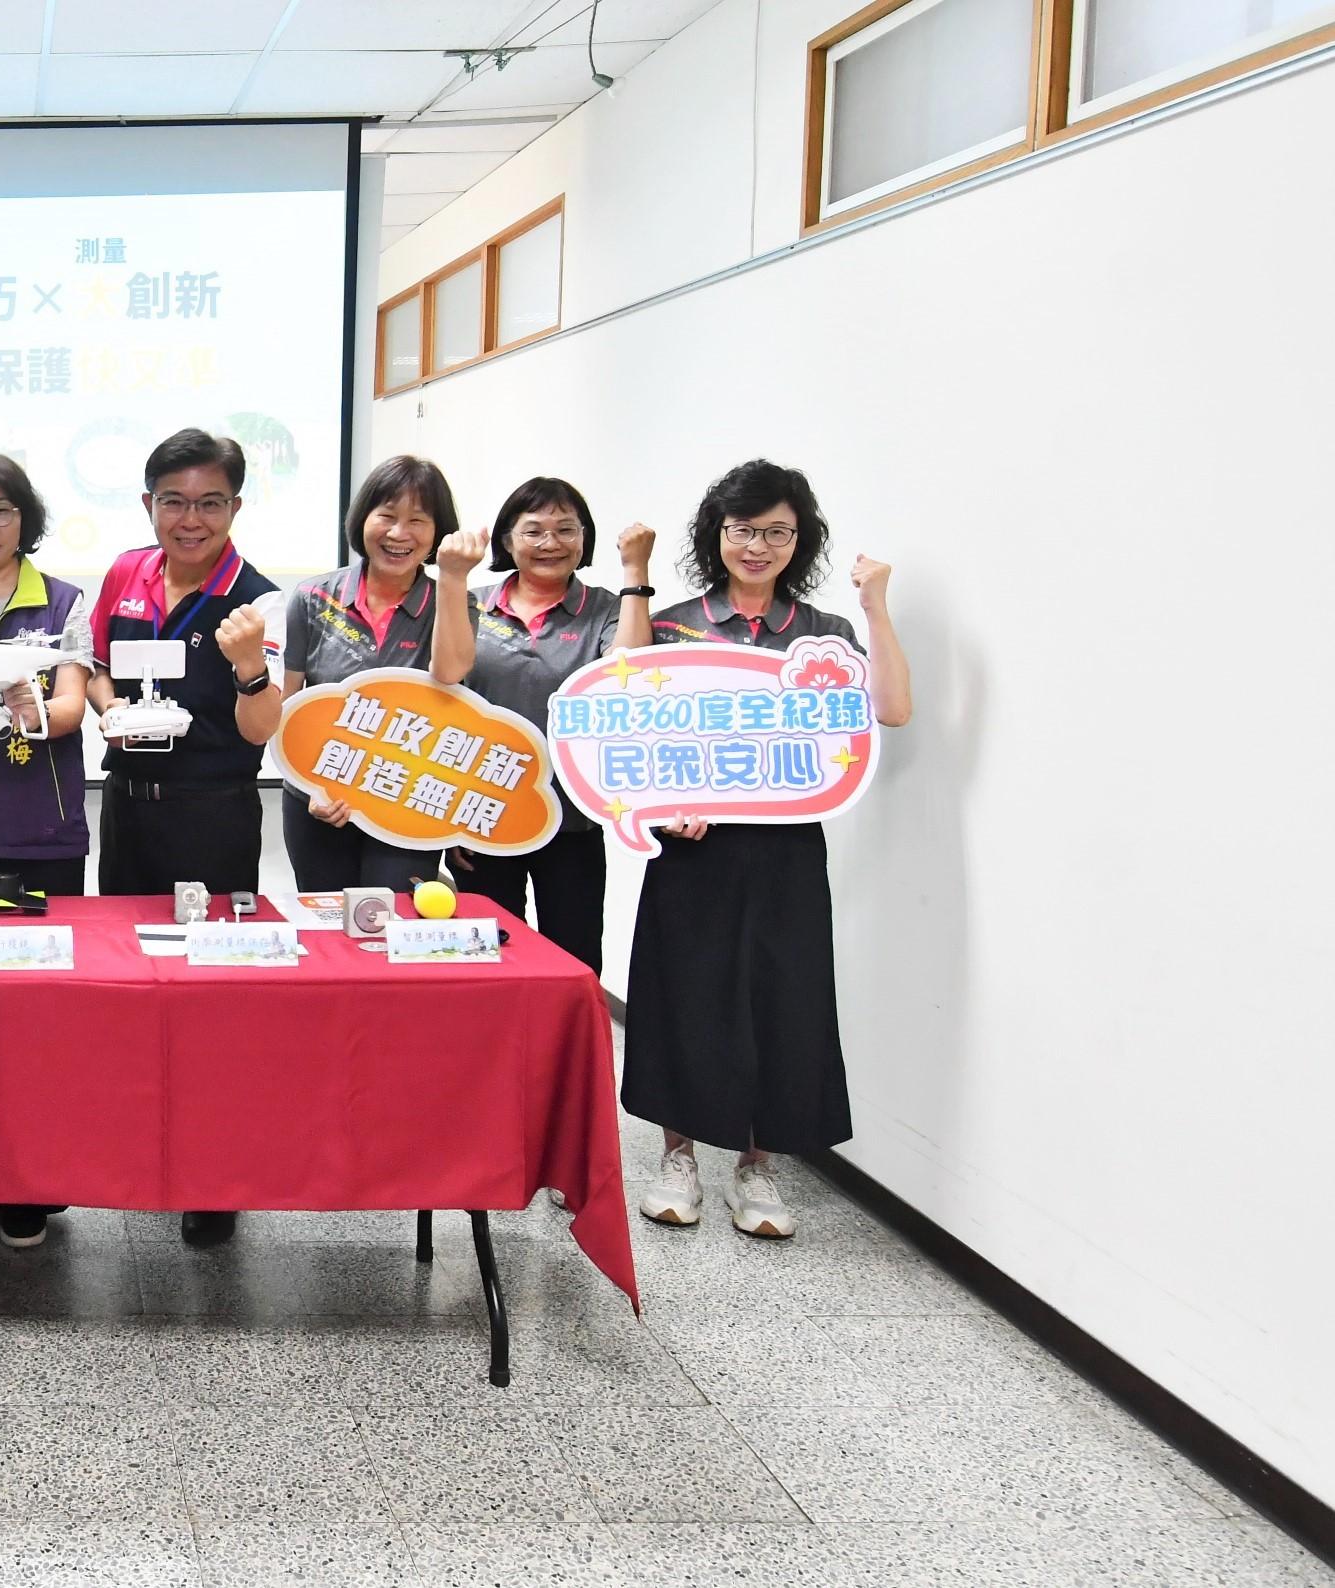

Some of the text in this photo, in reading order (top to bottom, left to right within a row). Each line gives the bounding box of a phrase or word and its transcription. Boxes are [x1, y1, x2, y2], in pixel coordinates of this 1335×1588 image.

[74, 237, 128, 265] 測量
[119, 599, 145, 612] FILA
[399, 641, 418, 649] FILA
[559, 633, 579, 641] FILA
[555, 691, 865, 734] 現況360度全紀錄
[7, 725, 33, 766] 梅
[333, 692, 533, 794] 地政創新
[312, 738, 506, 838] 創造無限
